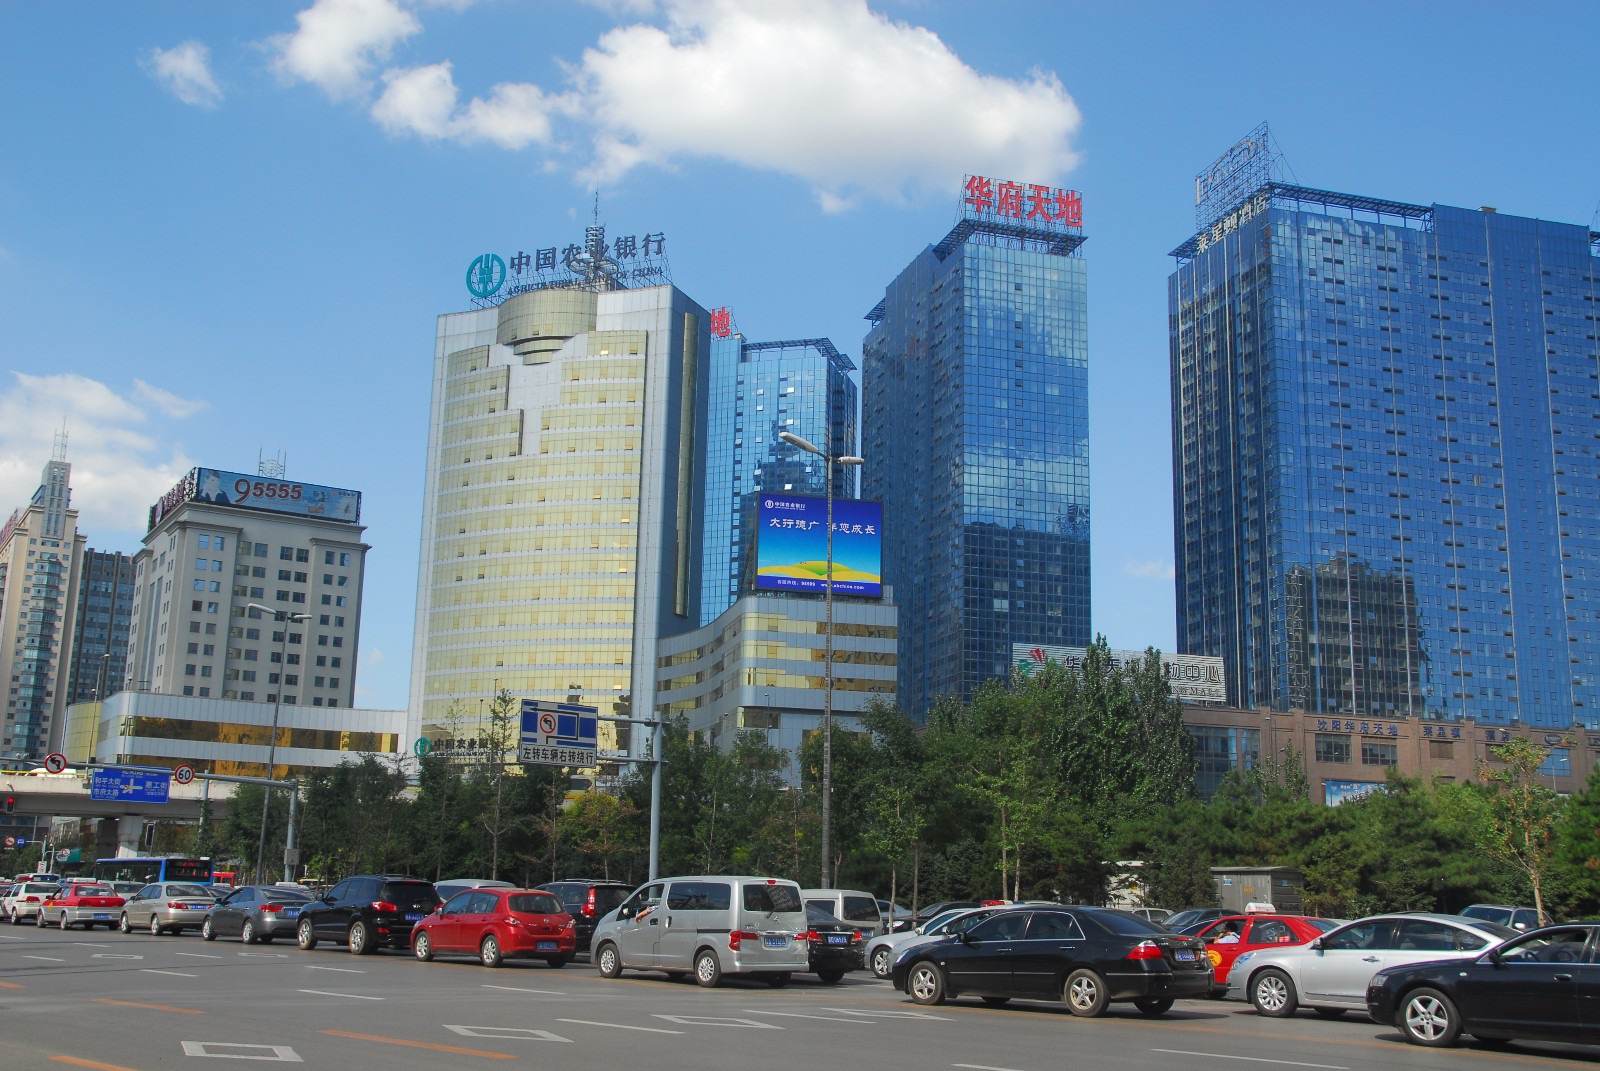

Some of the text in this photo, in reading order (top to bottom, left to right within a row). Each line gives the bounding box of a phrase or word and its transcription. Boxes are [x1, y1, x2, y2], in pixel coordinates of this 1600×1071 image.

[965, 175, 1083, 227] 华府天地
[510, 232, 666, 274] 中国农业银行
[632, 266, 664, 278] CHINA
[711, 306, 731, 337] 地
[234, 479, 302, 504] 95555
[1317, 719, 1398, 736] 沈阳华府天地
[523, 746, 594, 765] 左转车辆右转绕行
[178, 769, 191, 780] 60
